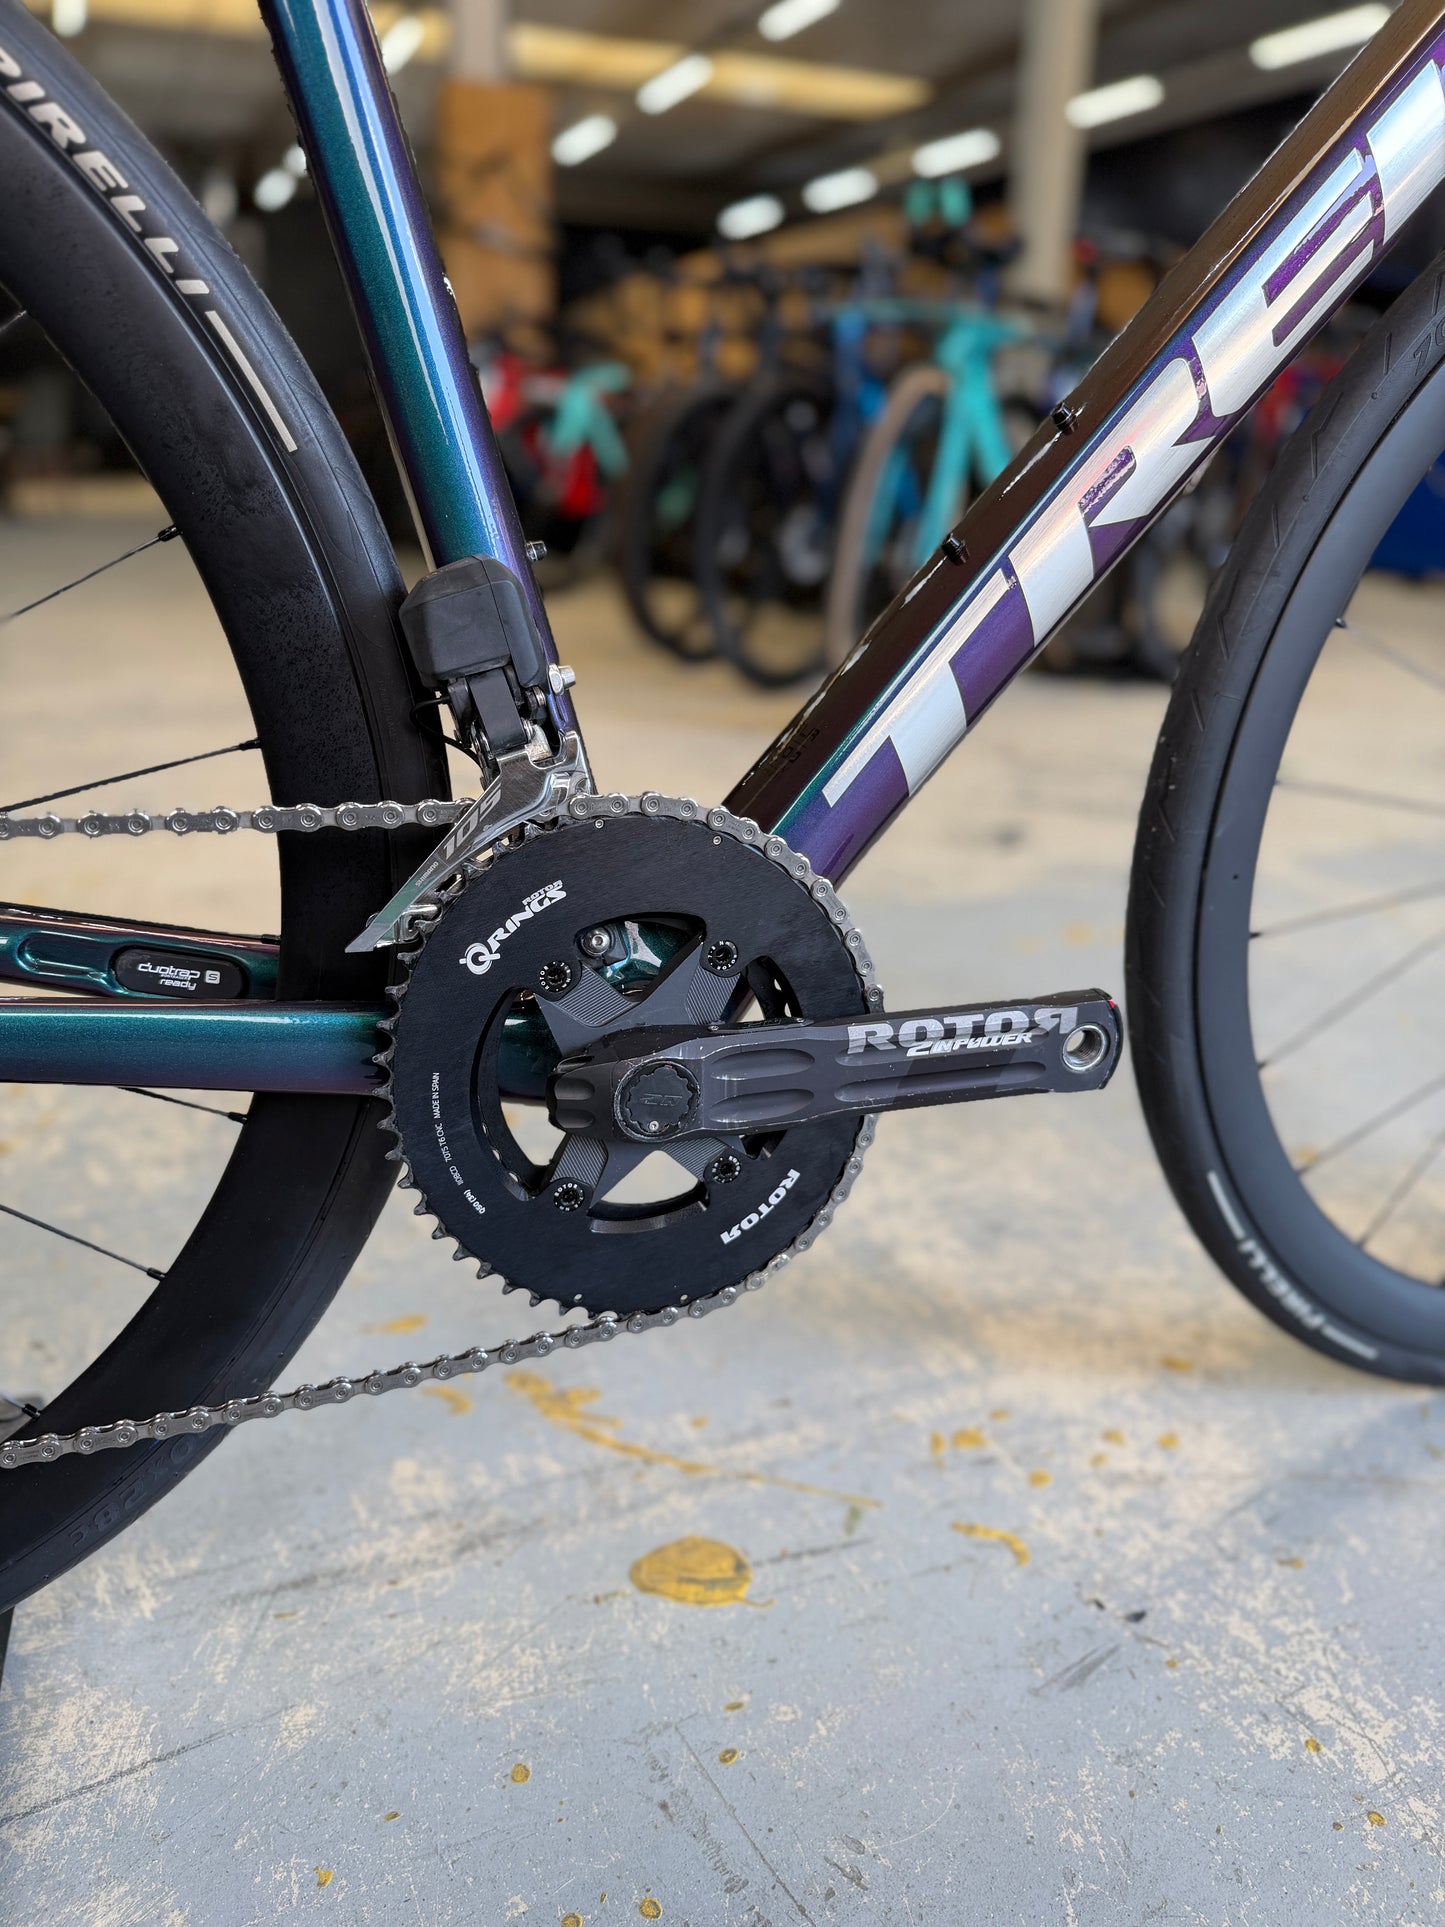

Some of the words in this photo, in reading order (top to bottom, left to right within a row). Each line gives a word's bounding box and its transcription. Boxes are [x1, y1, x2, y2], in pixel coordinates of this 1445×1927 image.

[443, 783, 502, 861] 105
[414, 861, 439, 887] SHIMANO
[522, 879, 564, 906] ROTOR
[138, 962, 201, 981] duotrap
[159, 978, 197, 991] ready
[846, 1006, 1078, 1054] ROTOR
[432, 1072, 440, 1092] SPAIN
[432, 1099, 441, 1119] MADE
[434, 1122, 445, 1137] CNC
[441, 1146, 453, 1163] 7075
[473, 1201, 486, 1215] Q50
[720, 1168, 801, 1244] ROTOR
